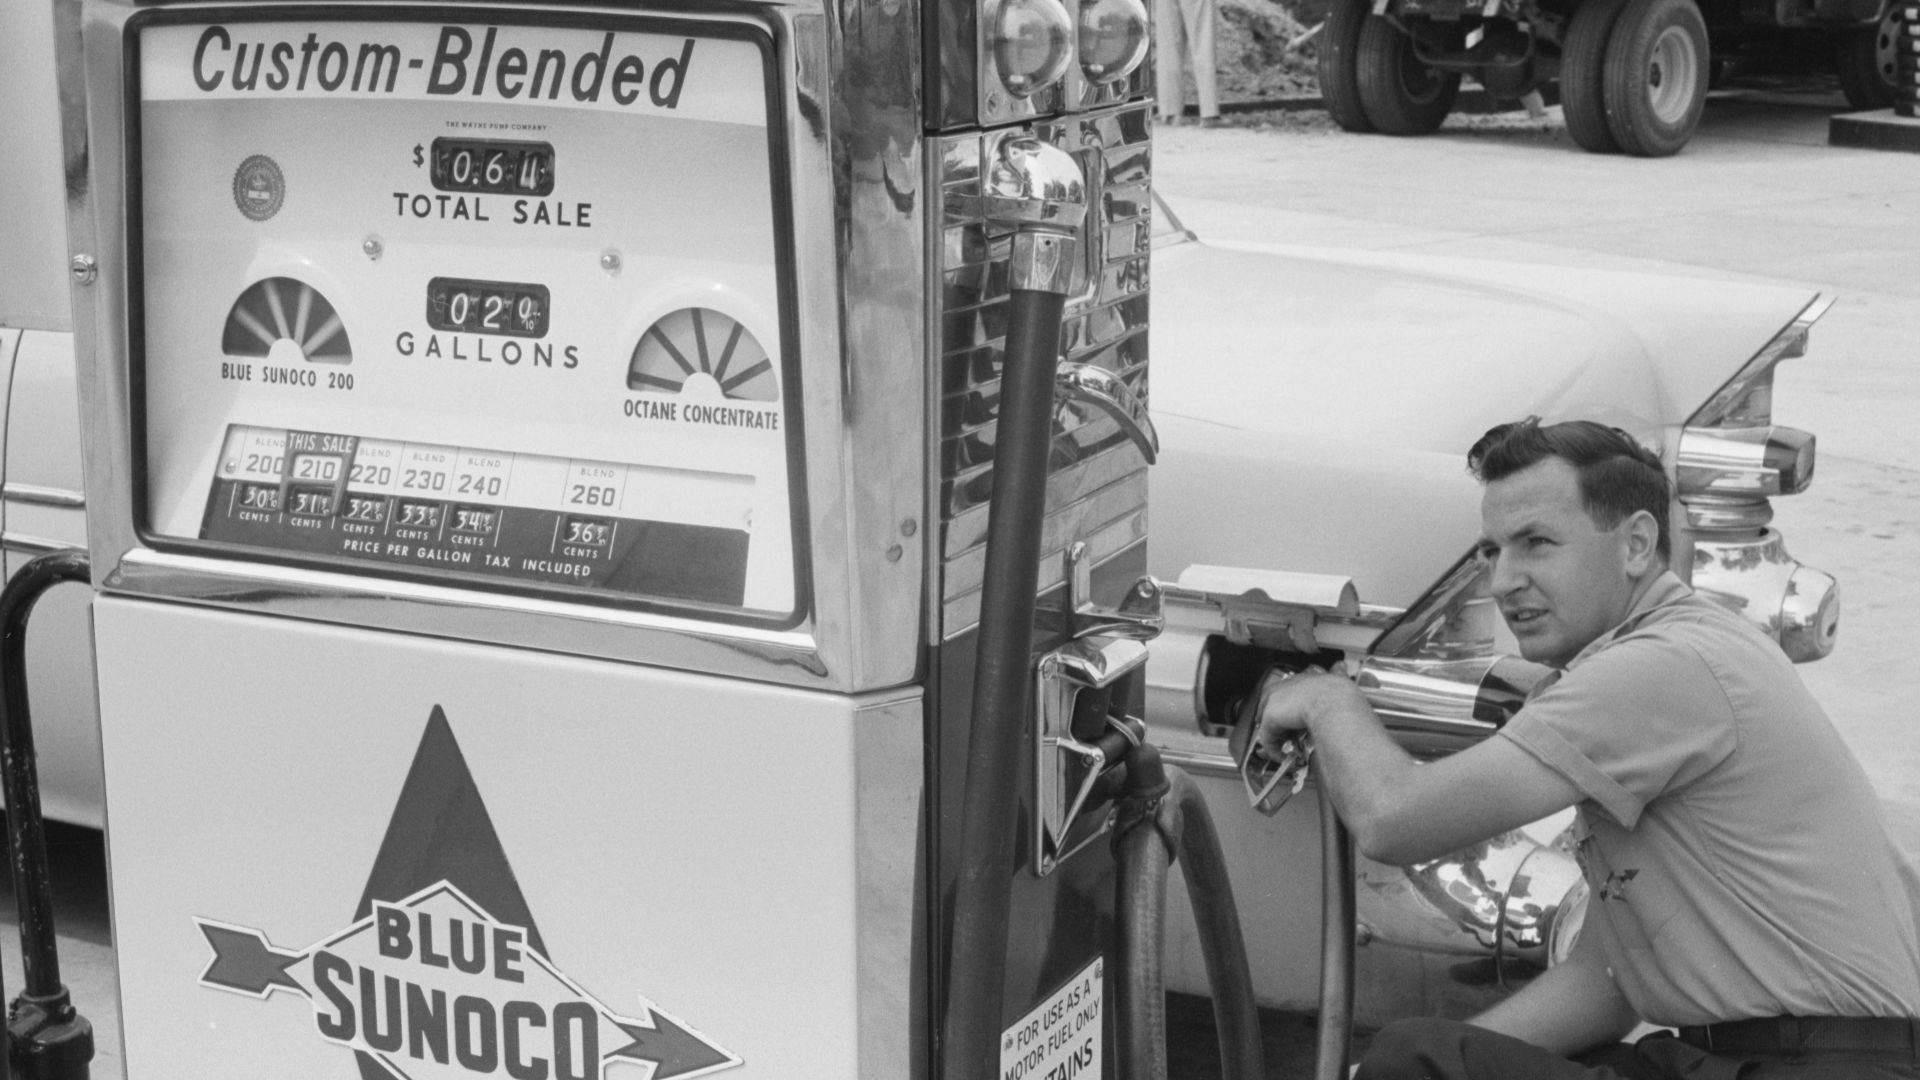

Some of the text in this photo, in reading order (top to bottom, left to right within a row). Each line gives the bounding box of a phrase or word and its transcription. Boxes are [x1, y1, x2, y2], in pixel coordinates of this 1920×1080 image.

[193, 26, 695, 109] Custom-Blended
[445, 120, 547, 131] THE WAYNE PUMP COMPANY
[413, 143, 424, 168] $
[393, 192, 592, 228] TOTAL SALE
[396, 331, 579, 369] GALLONS
[221, 362, 354, 390] BLUE SUNOCO 200
[624, 399, 778, 430] OCTANE CONCENTRATE
[255, 437, 286, 448] BLEND
[289, 432, 353, 453] THIS SALE
[359, 447, 391, 458] BLEND
[246, 454, 284, 475] 200
[412, 452, 446, 463] BLEND
[468, 457, 502, 468] BLEND
[300, 459, 336, 479] 210
[350, 464, 391, 486] 220
[403, 469, 446, 491] 230
[580, 467, 615, 478] BLEND
[457, 474, 501, 496] 240
[570, 484, 616, 507] 260
[240, 511, 270, 522] CENTS
[291, 517, 322, 528] CENTS
[343, 523, 375, 535] CENTS
[396, 529, 429, 540] CENTS
[451, 535, 484, 546] CENTS
[343, 539, 591, 577] PRICE PER GALLON TAX INCLUDED
[564, 546, 598, 559] CENTS
[377, 906, 525, 983] BLUE
[313, 950, 599, 1080] SUNOCO
[1017, 978, 1091, 1051] FOR USE AS A
[1005, 997, 1100, 1080] MOTOR FUEL ONLY
[1044, 1037, 1092, 1080] TAINS
